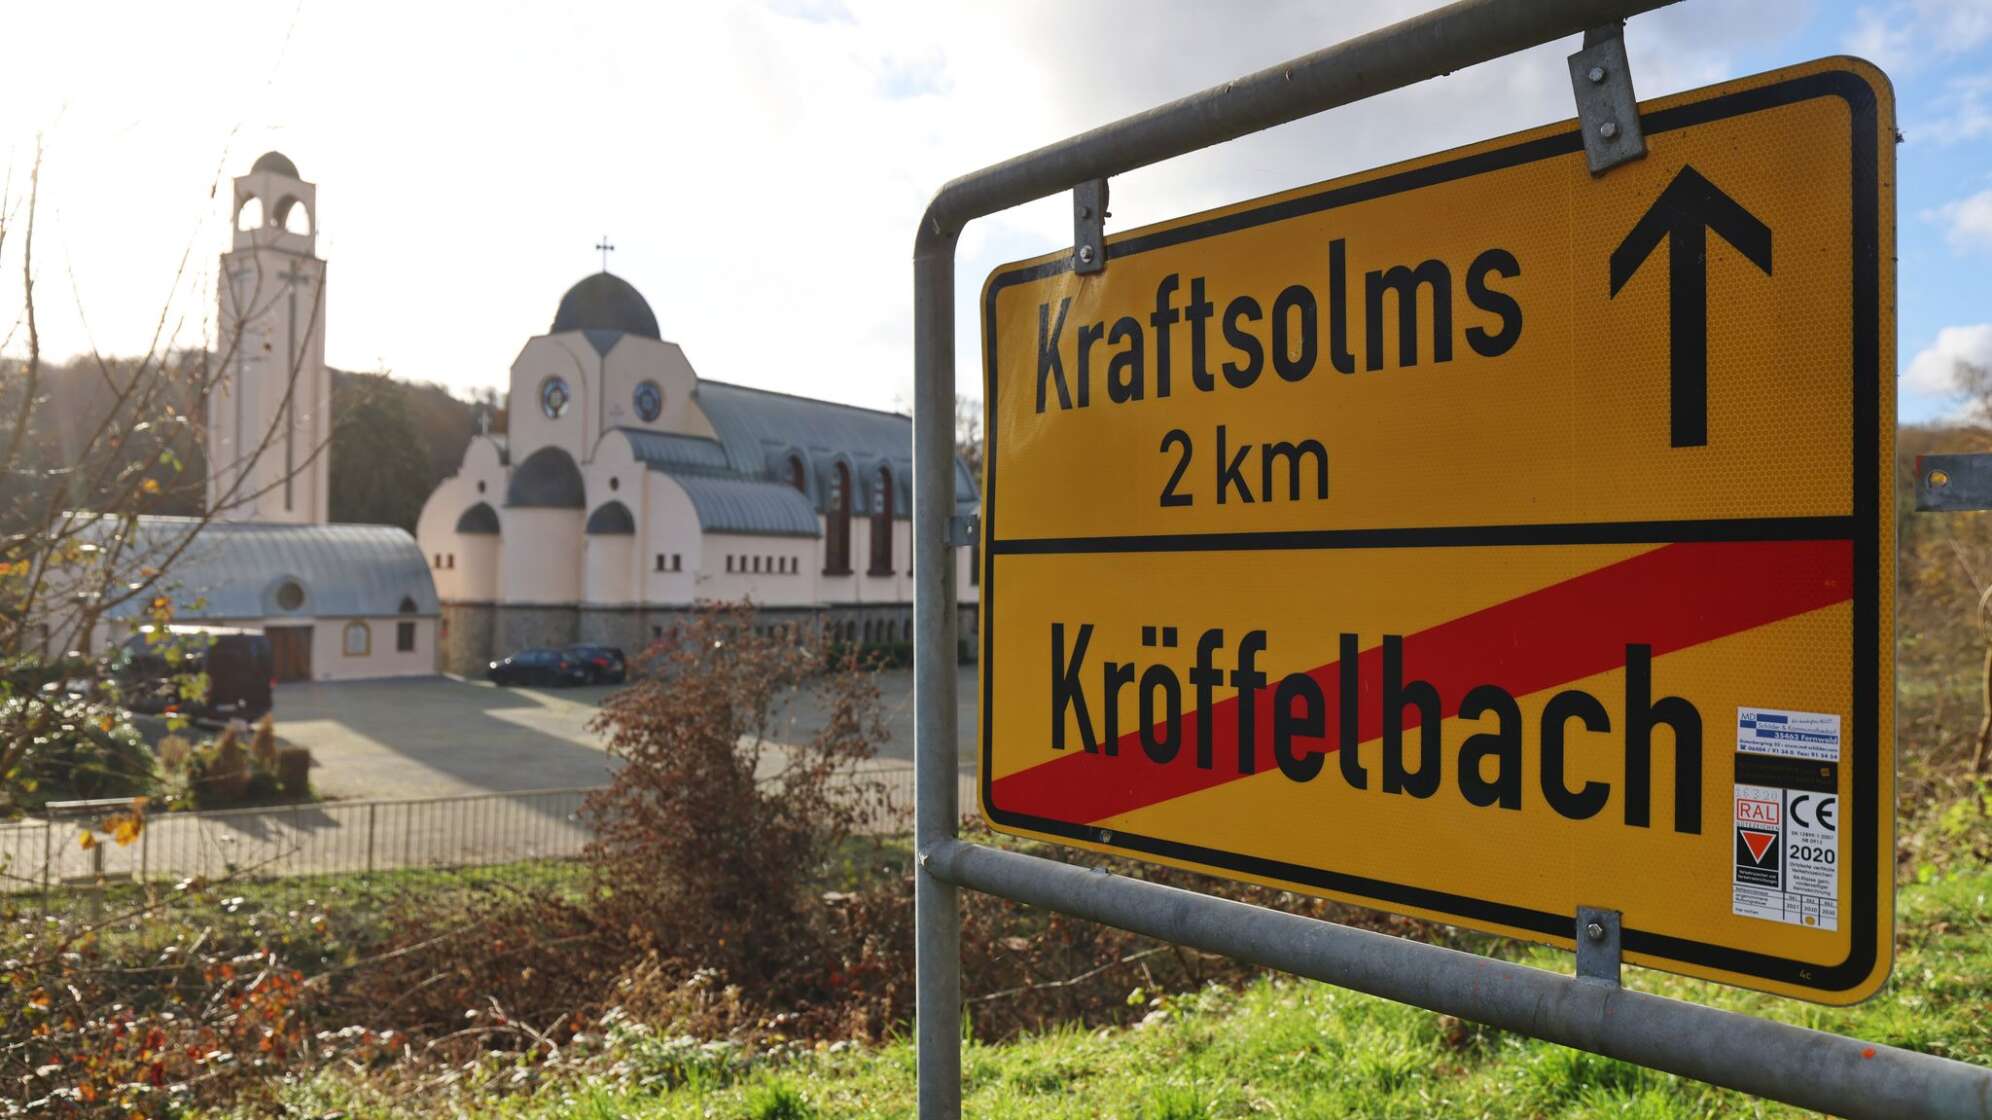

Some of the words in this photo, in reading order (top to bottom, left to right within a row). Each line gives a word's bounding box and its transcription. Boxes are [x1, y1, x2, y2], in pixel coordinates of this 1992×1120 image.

[1037, 238, 1523, 414] Kraftsolms
[1159, 429, 1194, 508] 2
[1215, 425, 1329, 505] km
[1050, 622, 1703, 836] Kröffelbach
[1740, 802, 1776, 821] RAL
[1789, 844, 1836, 865] 2020
